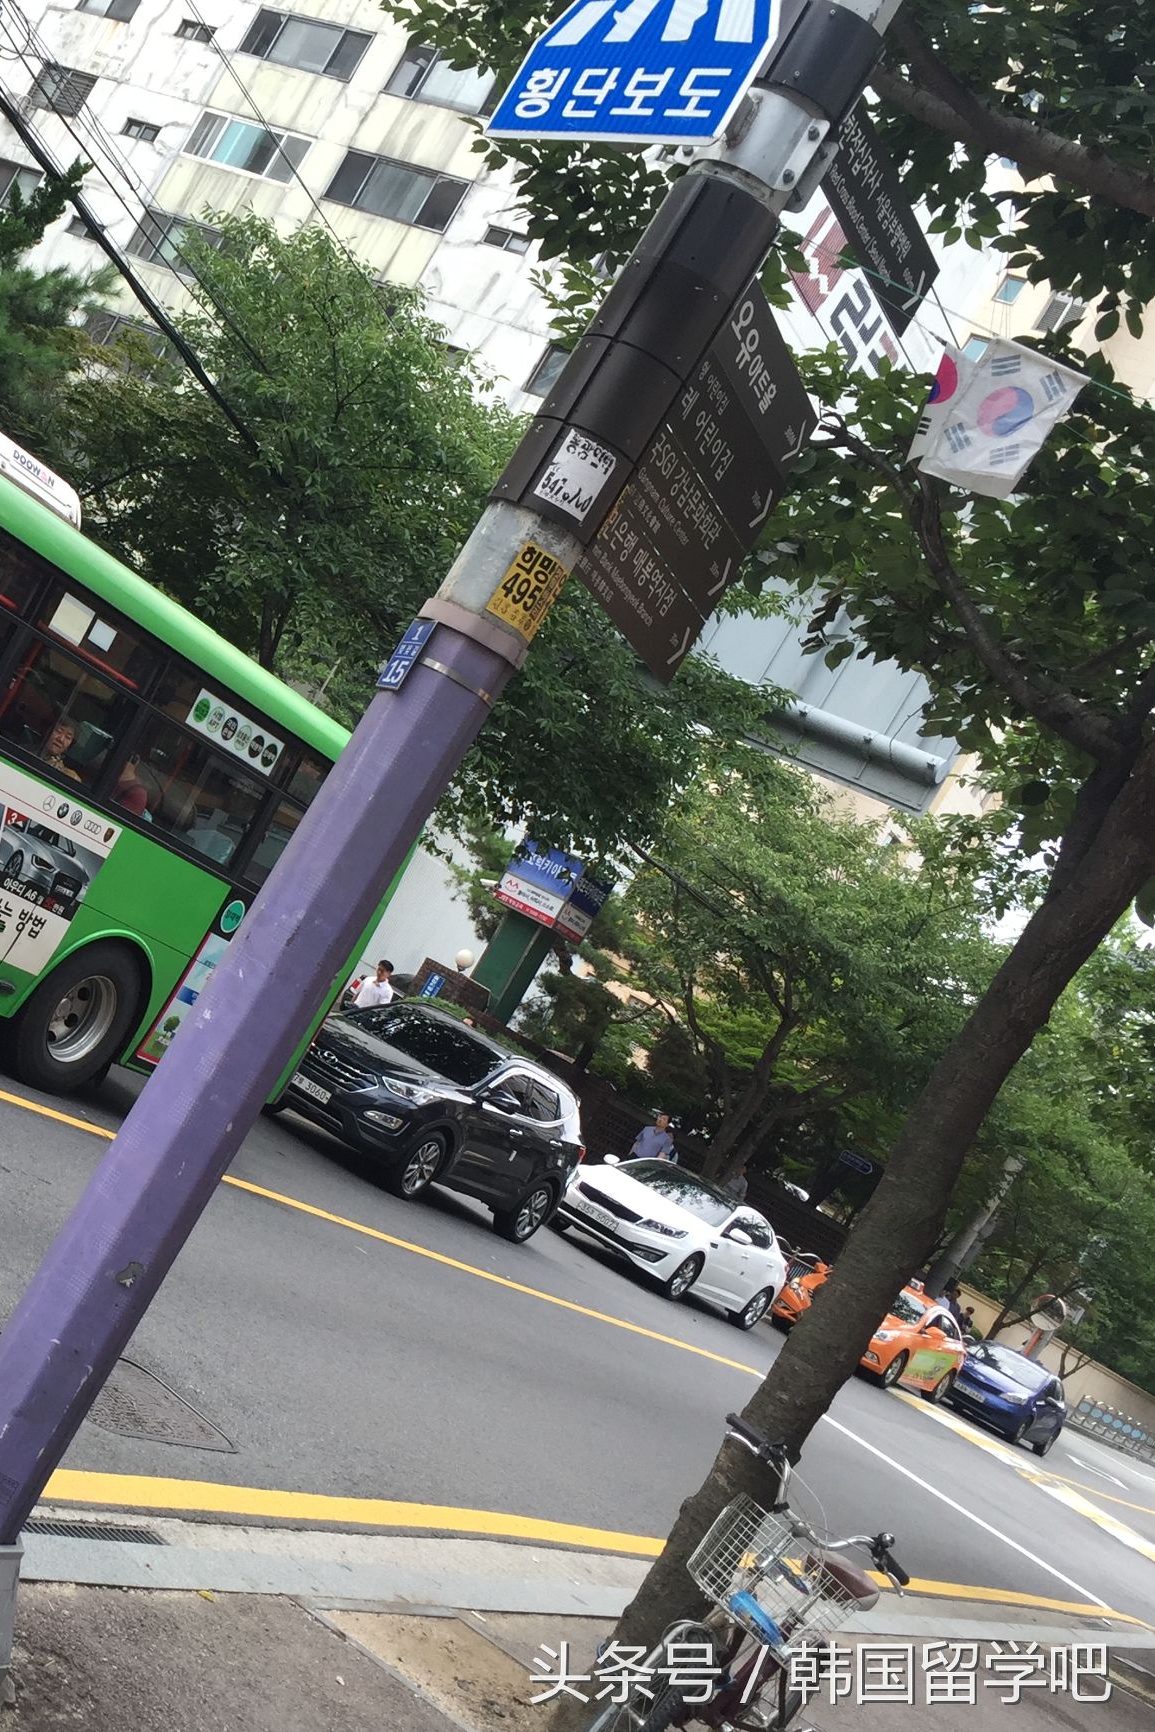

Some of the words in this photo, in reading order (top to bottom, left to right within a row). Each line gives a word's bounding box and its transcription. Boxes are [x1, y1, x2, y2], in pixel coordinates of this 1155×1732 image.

[514, 66, 733, 119] 횡단보도
[695, 410, 735, 482] 어린이집
[515, 545, 557, 585] 희망
[500, 571, 542, 613] 495
[381, 660, 410, 683] 15
[7, 813, 18, 825] 3
[4, 877, 27, 896] 아우디
[23, 887, 37, 901] A6
[15, 907, 47, 939] 방법
[305, 1081, 327, 1101] 3060
